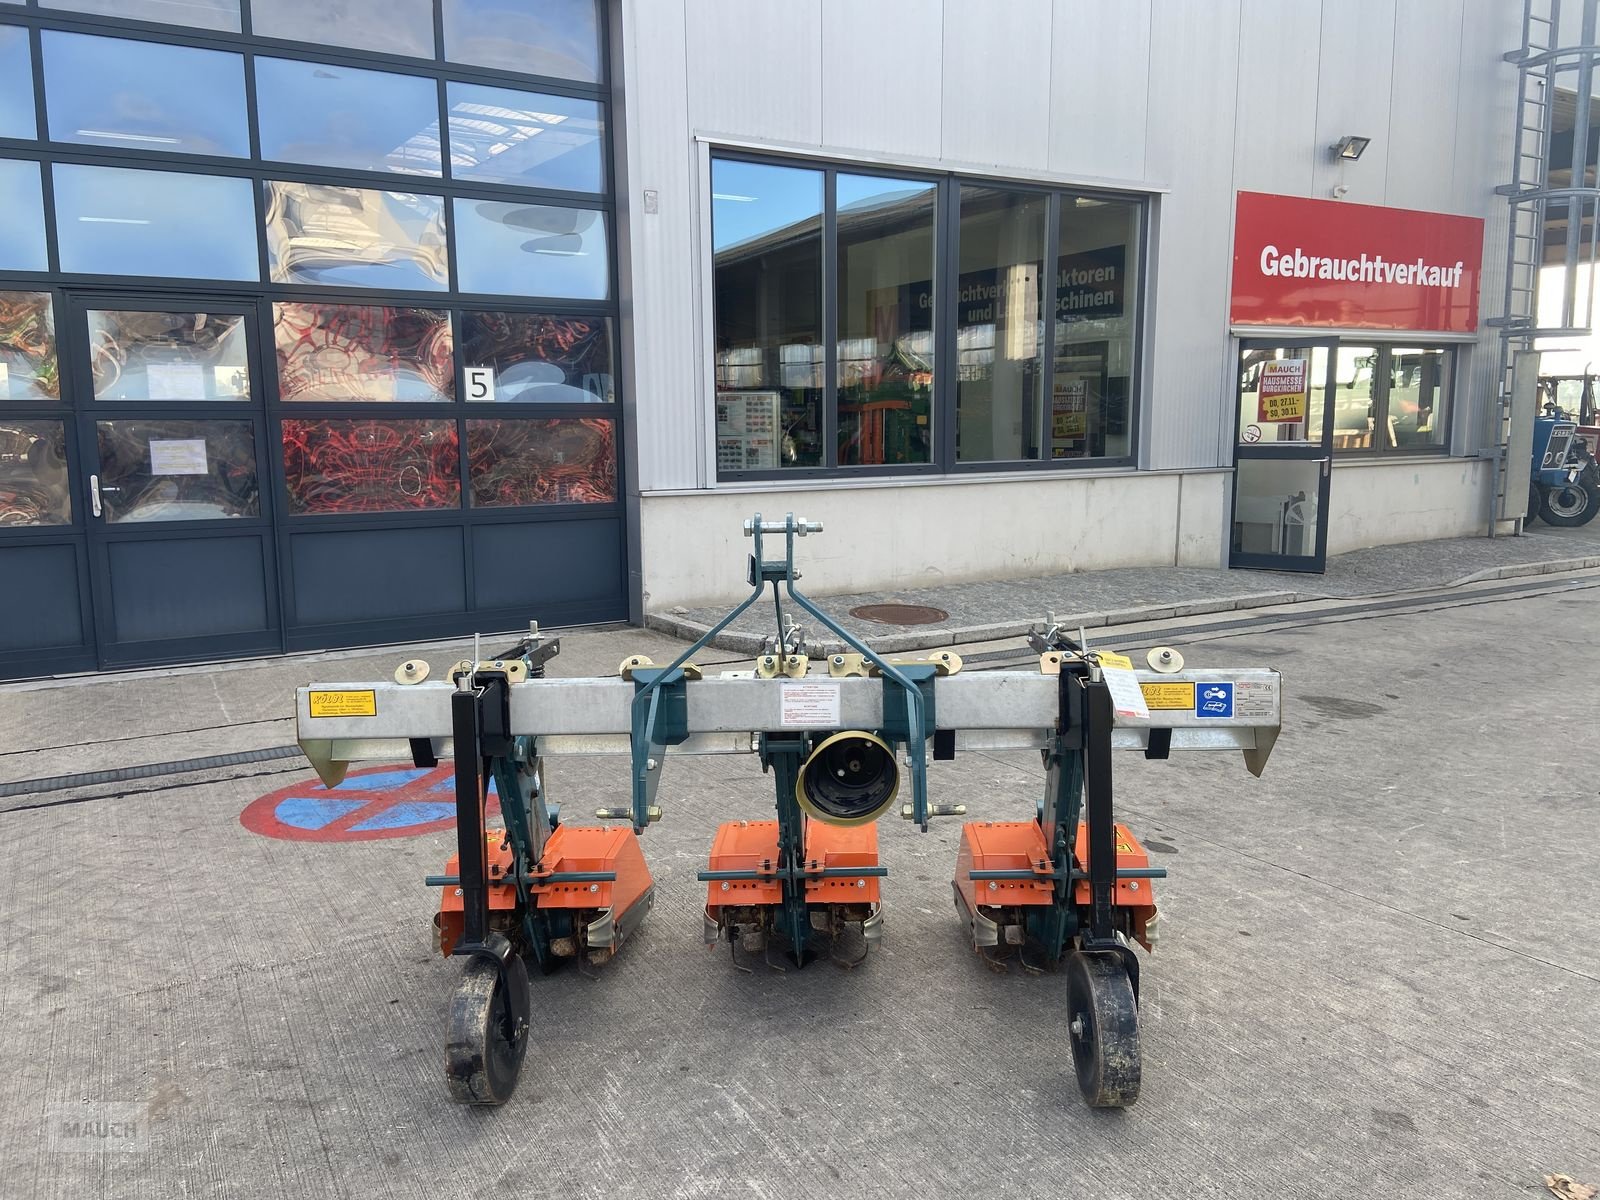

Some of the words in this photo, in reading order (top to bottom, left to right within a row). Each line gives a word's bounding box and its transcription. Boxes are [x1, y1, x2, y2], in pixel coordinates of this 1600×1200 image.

[1260, 245, 1463, 288] Gebrauchtverkauf
[967, 304, 993, 323] und
[471, 372, 488, 398] 5
[1263, 377, 1302, 385] HAUSMESSE
